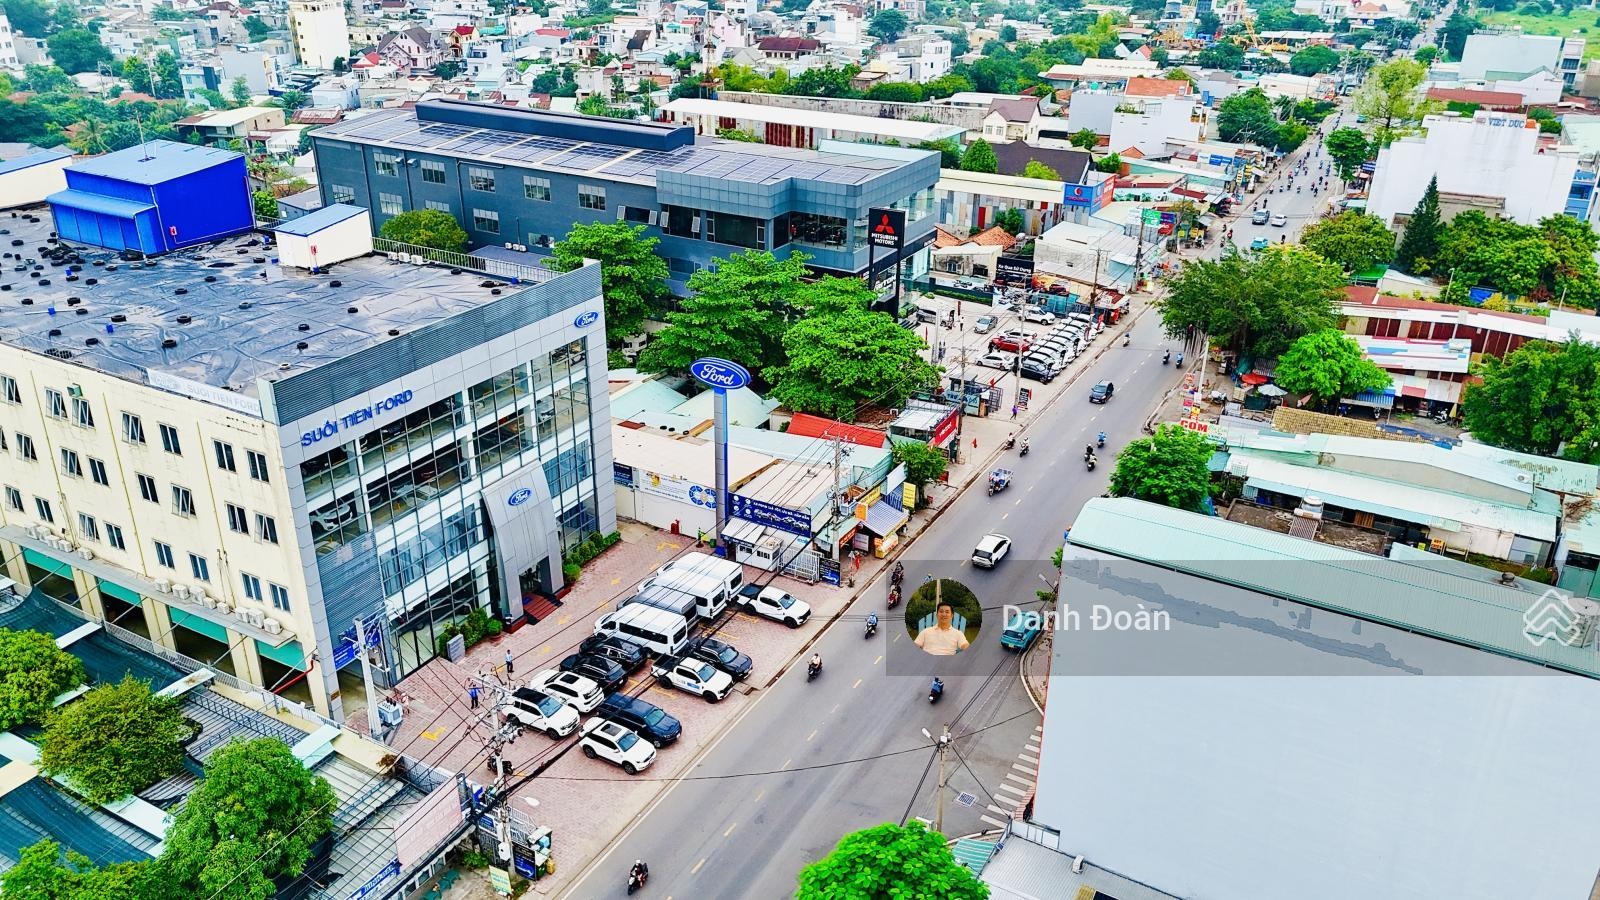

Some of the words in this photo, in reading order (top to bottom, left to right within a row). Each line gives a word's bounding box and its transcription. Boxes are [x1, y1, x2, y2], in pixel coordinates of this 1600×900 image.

[871, 232, 898, 241] MITSUBISHI
[701, 364, 734, 385] Ford
[376, 389, 413, 415] FORD
